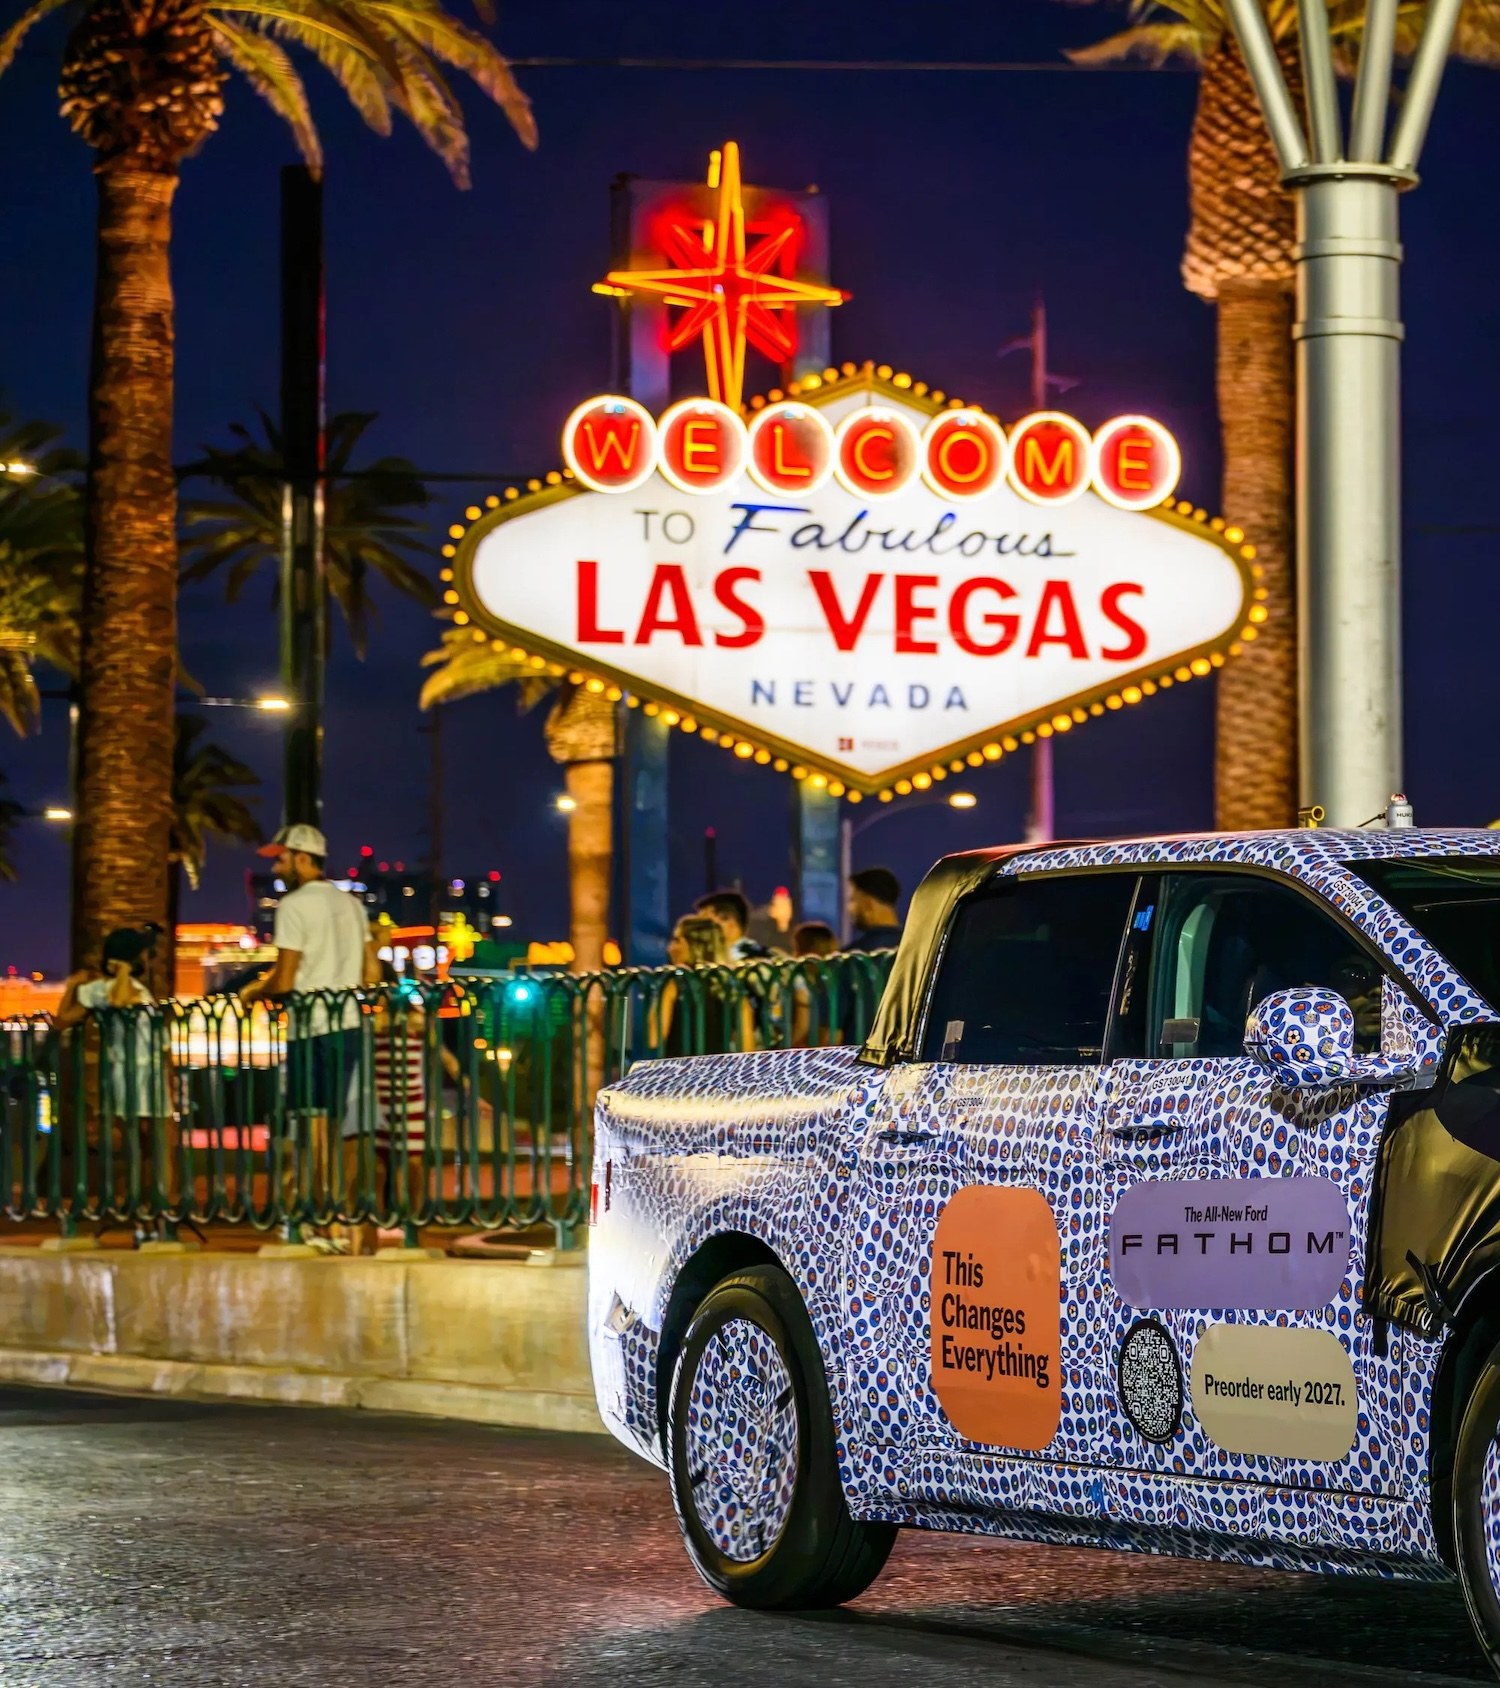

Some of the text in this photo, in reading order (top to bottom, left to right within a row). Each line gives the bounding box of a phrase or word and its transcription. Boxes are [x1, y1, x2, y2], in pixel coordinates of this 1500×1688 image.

[582, 419, 1154, 491] WELCOME
[636, 503, 1078, 557] TO Fabulous
[576, 560, 1148, 662] LAS VEGAS
[751, 680, 968, 711] NEVADA
[1333, 880, 1366, 911] GS730041
[1152, 1074, 1191, 1090] GS730041
[1184, 1204, 1269, 1223] The All-New Ford
[942, 1250, 984, 1289] This
[941, 1292, 1026, 1341] Changes
[941, 1334, 1050, 1389] Everything
[1204, 1373, 1346, 1407] Preorder early 2027.
